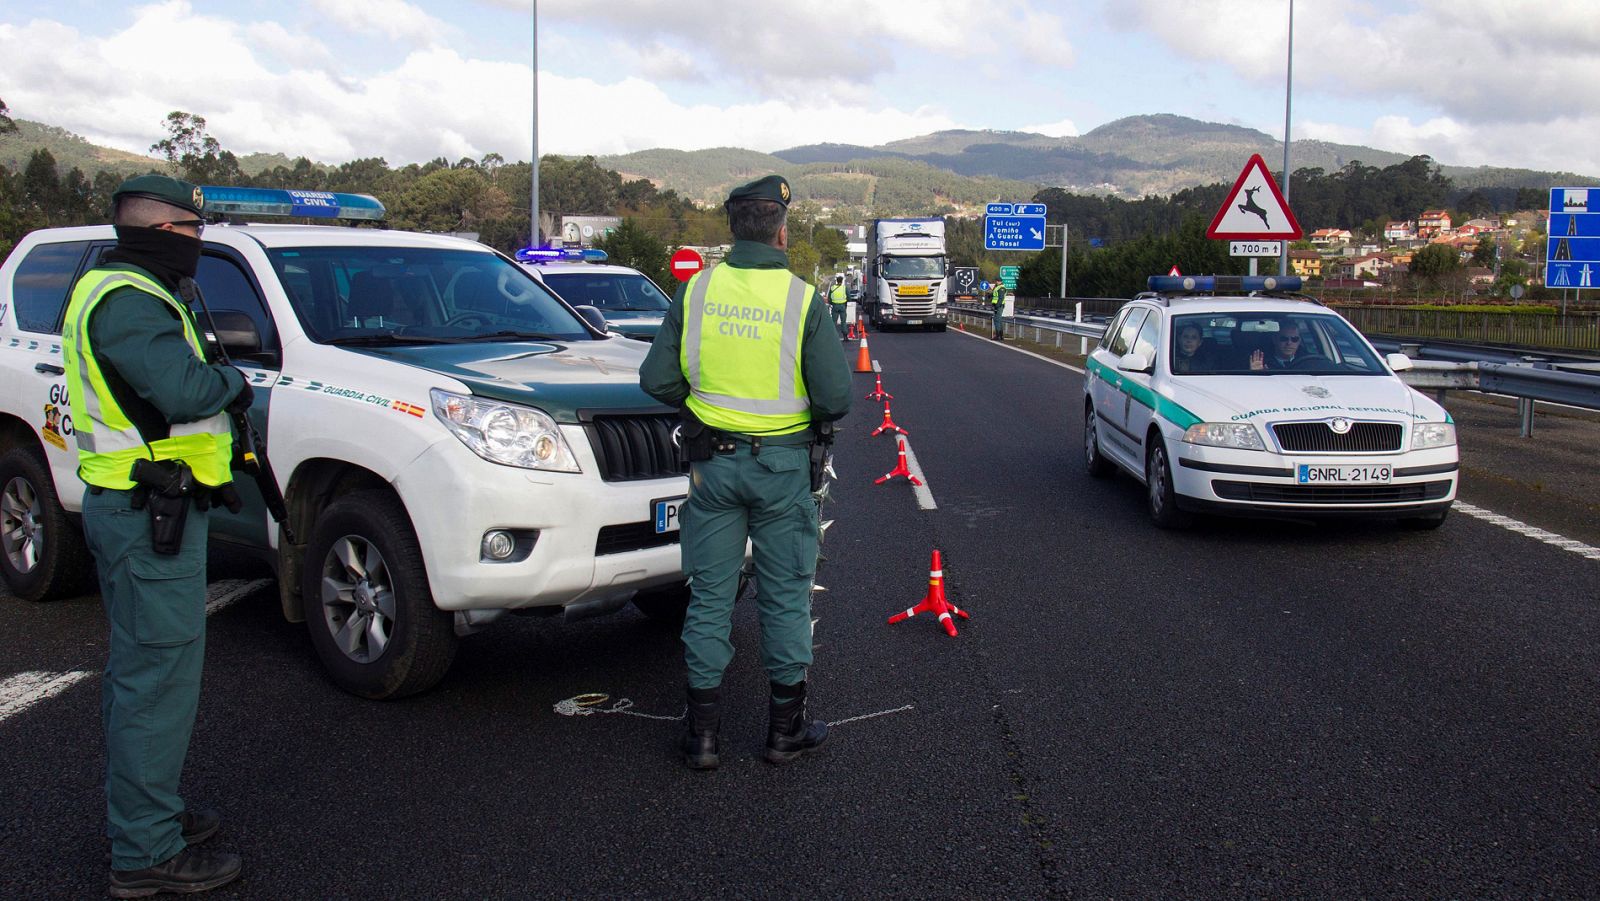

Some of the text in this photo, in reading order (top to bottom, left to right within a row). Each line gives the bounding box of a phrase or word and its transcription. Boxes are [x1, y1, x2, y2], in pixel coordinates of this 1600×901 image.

[291, 191, 335, 200] GUARDIA
[303, 198, 330, 206] CIVIL
[1242, 244, 1260, 253] 700
[703, 302, 782, 325] GUARDIA
[719, 321, 762, 340] CIVIL
[323, 386, 391, 407] GUARDIA CIVIL
[1231, 408, 1280, 421] GUARDA
[1347, 406, 1428, 420] REPUBLICANA
